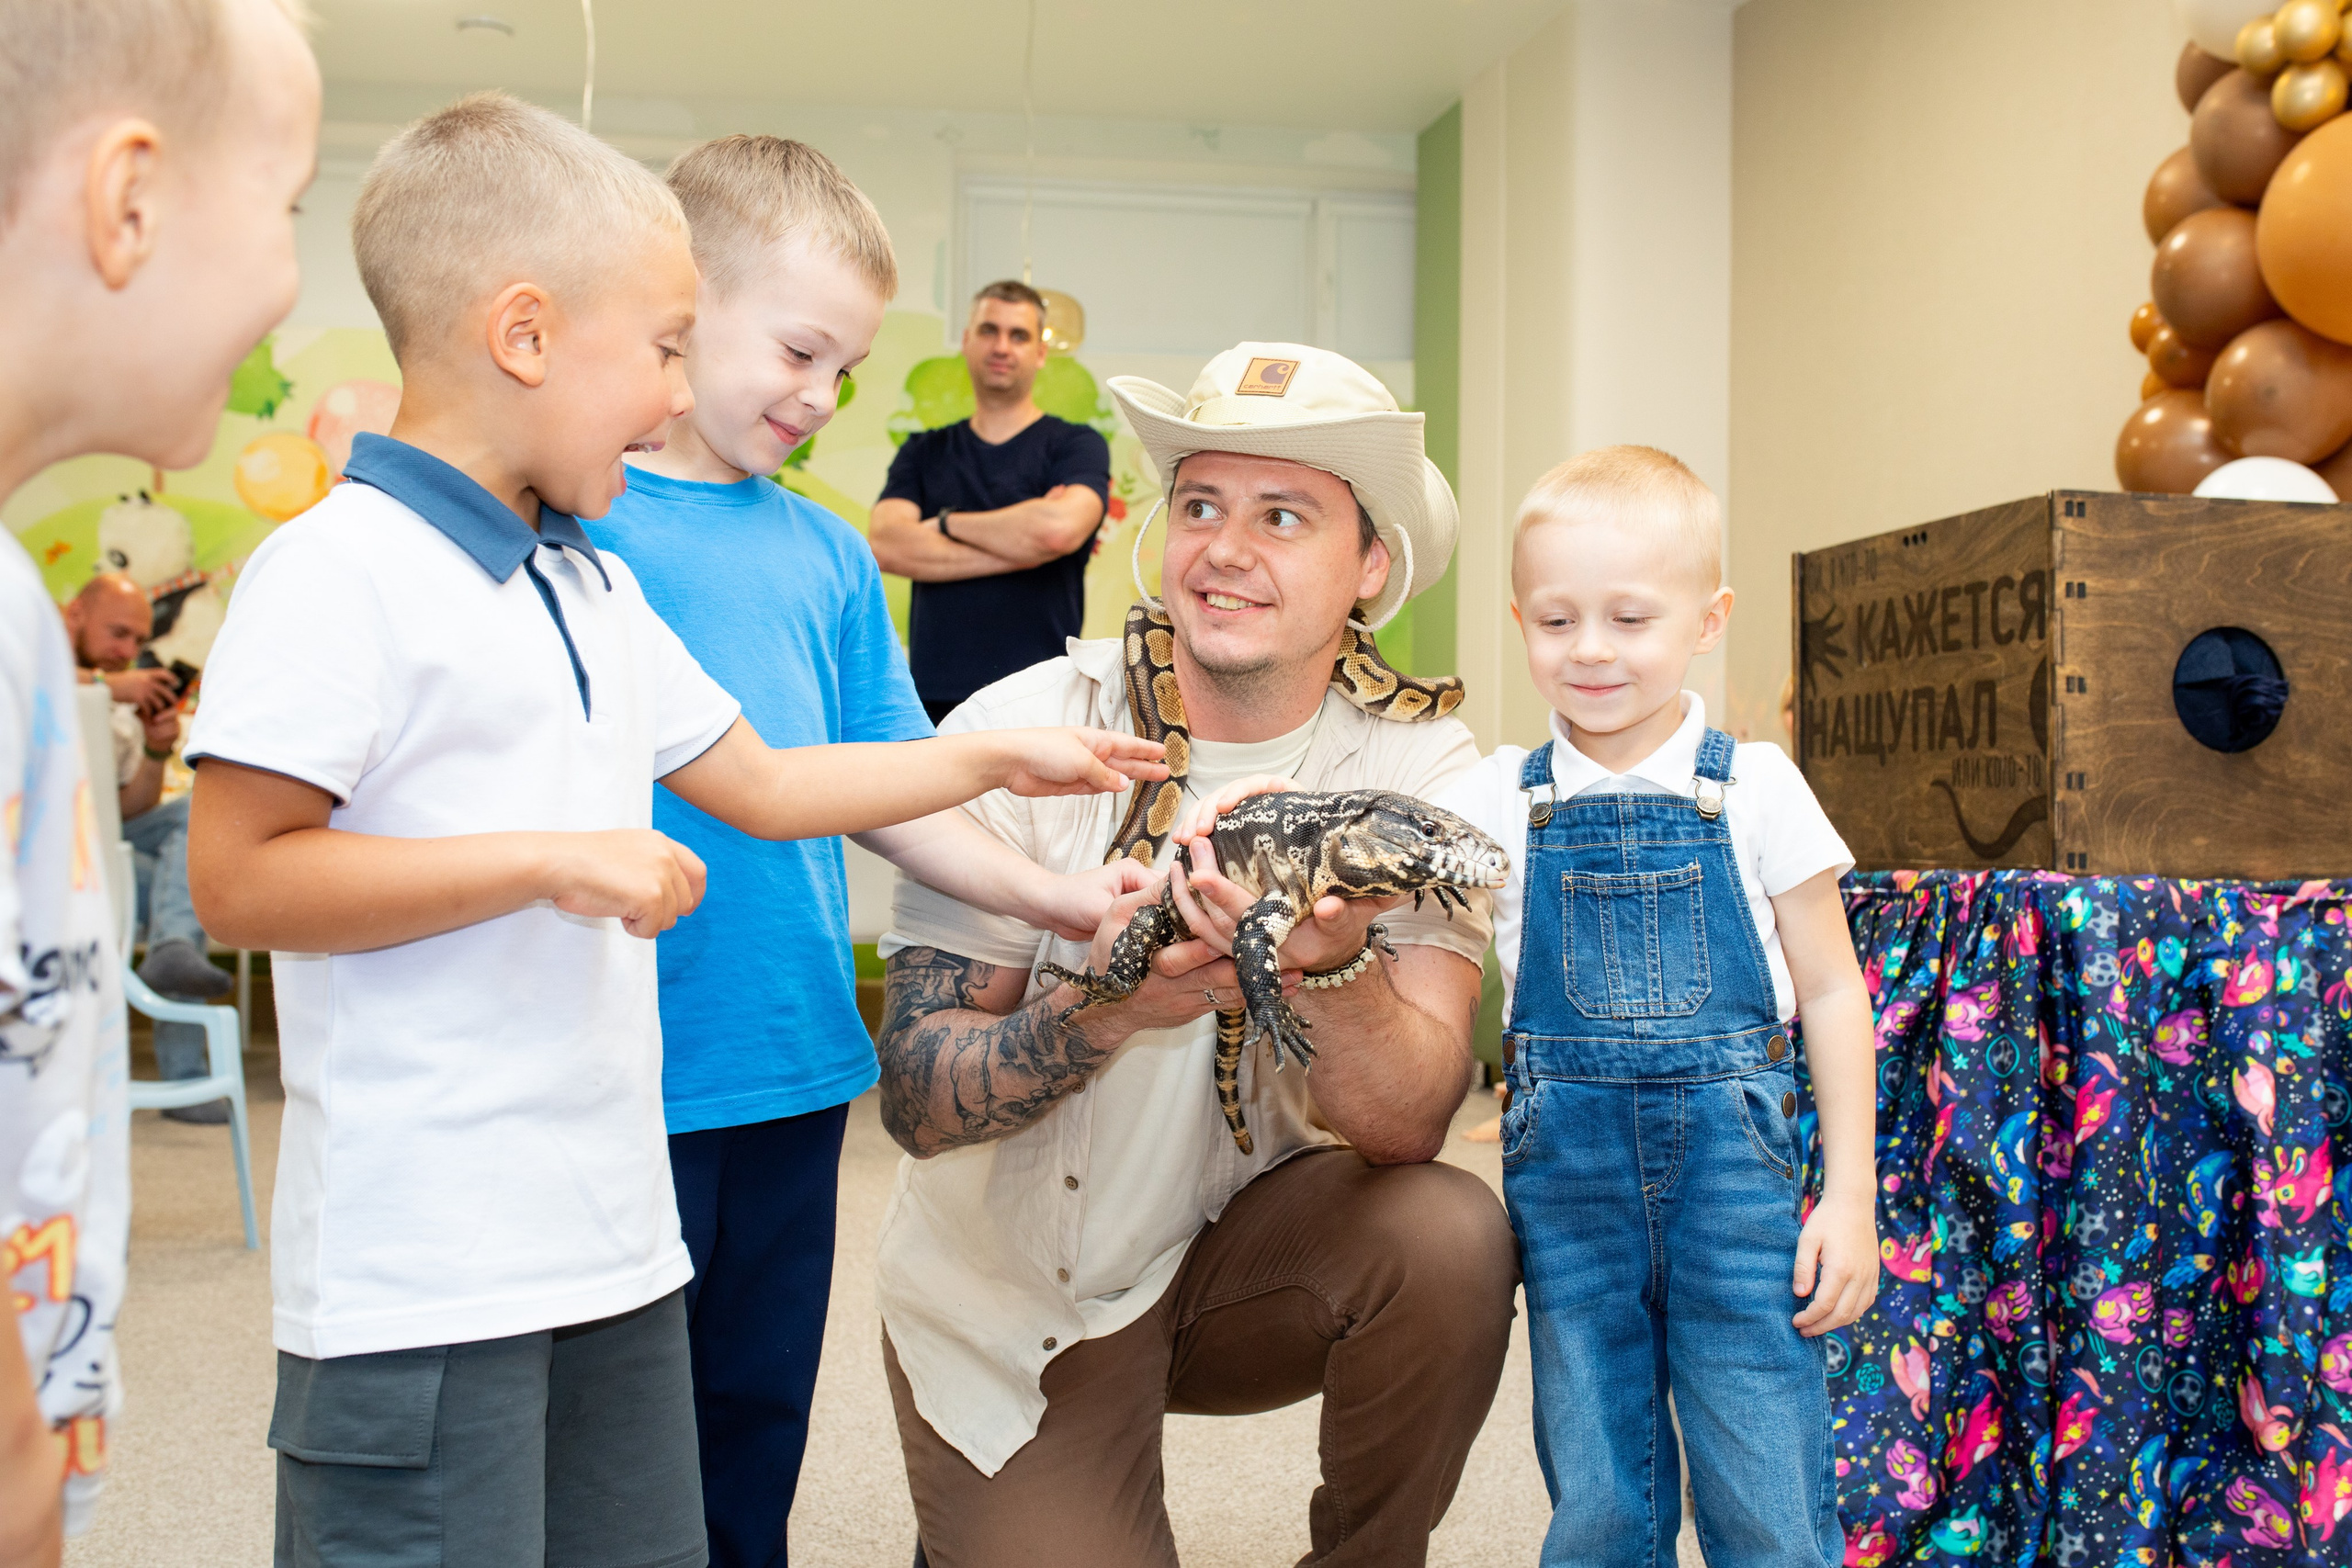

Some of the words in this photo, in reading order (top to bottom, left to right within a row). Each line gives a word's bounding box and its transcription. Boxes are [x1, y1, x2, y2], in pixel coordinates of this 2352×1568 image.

[1856, 569, 2047, 663] КАЖЕТСЯ
[1807, 679, 1996, 766] НАЩУПАЛ
[1951, 757, 1980, 788] ИЛИ
